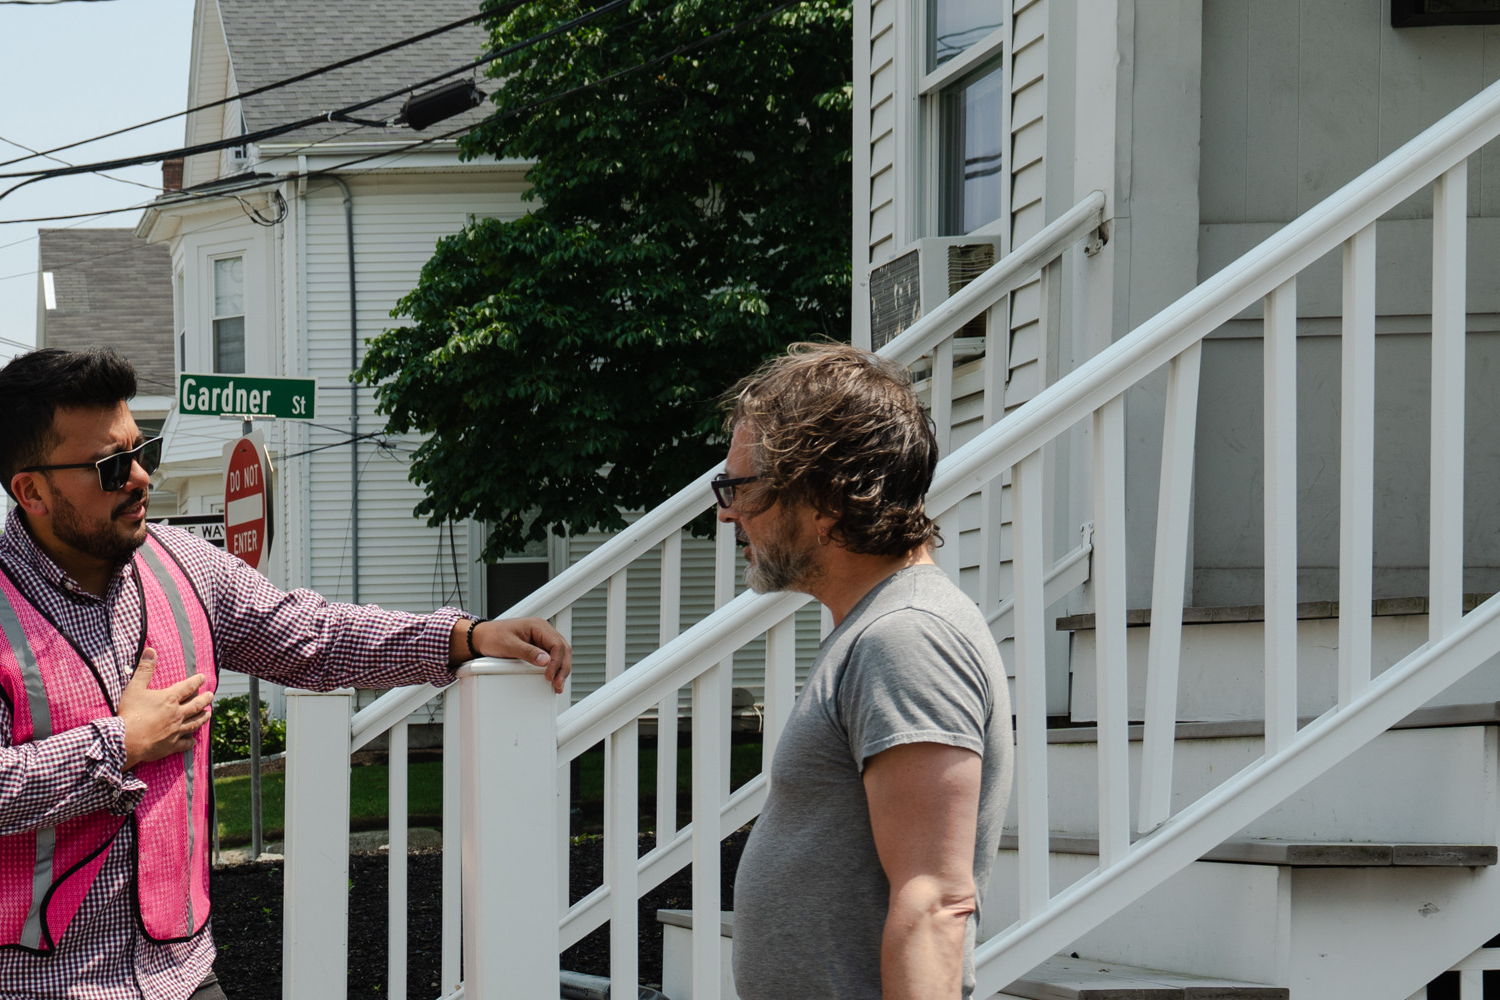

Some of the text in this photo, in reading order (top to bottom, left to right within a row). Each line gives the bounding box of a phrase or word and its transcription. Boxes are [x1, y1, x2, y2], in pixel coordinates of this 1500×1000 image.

[182, 378, 306, 415] Gardner St
[230, 464, 259, 493] DO NOT
[233, 530, 258, 555] ENTER
